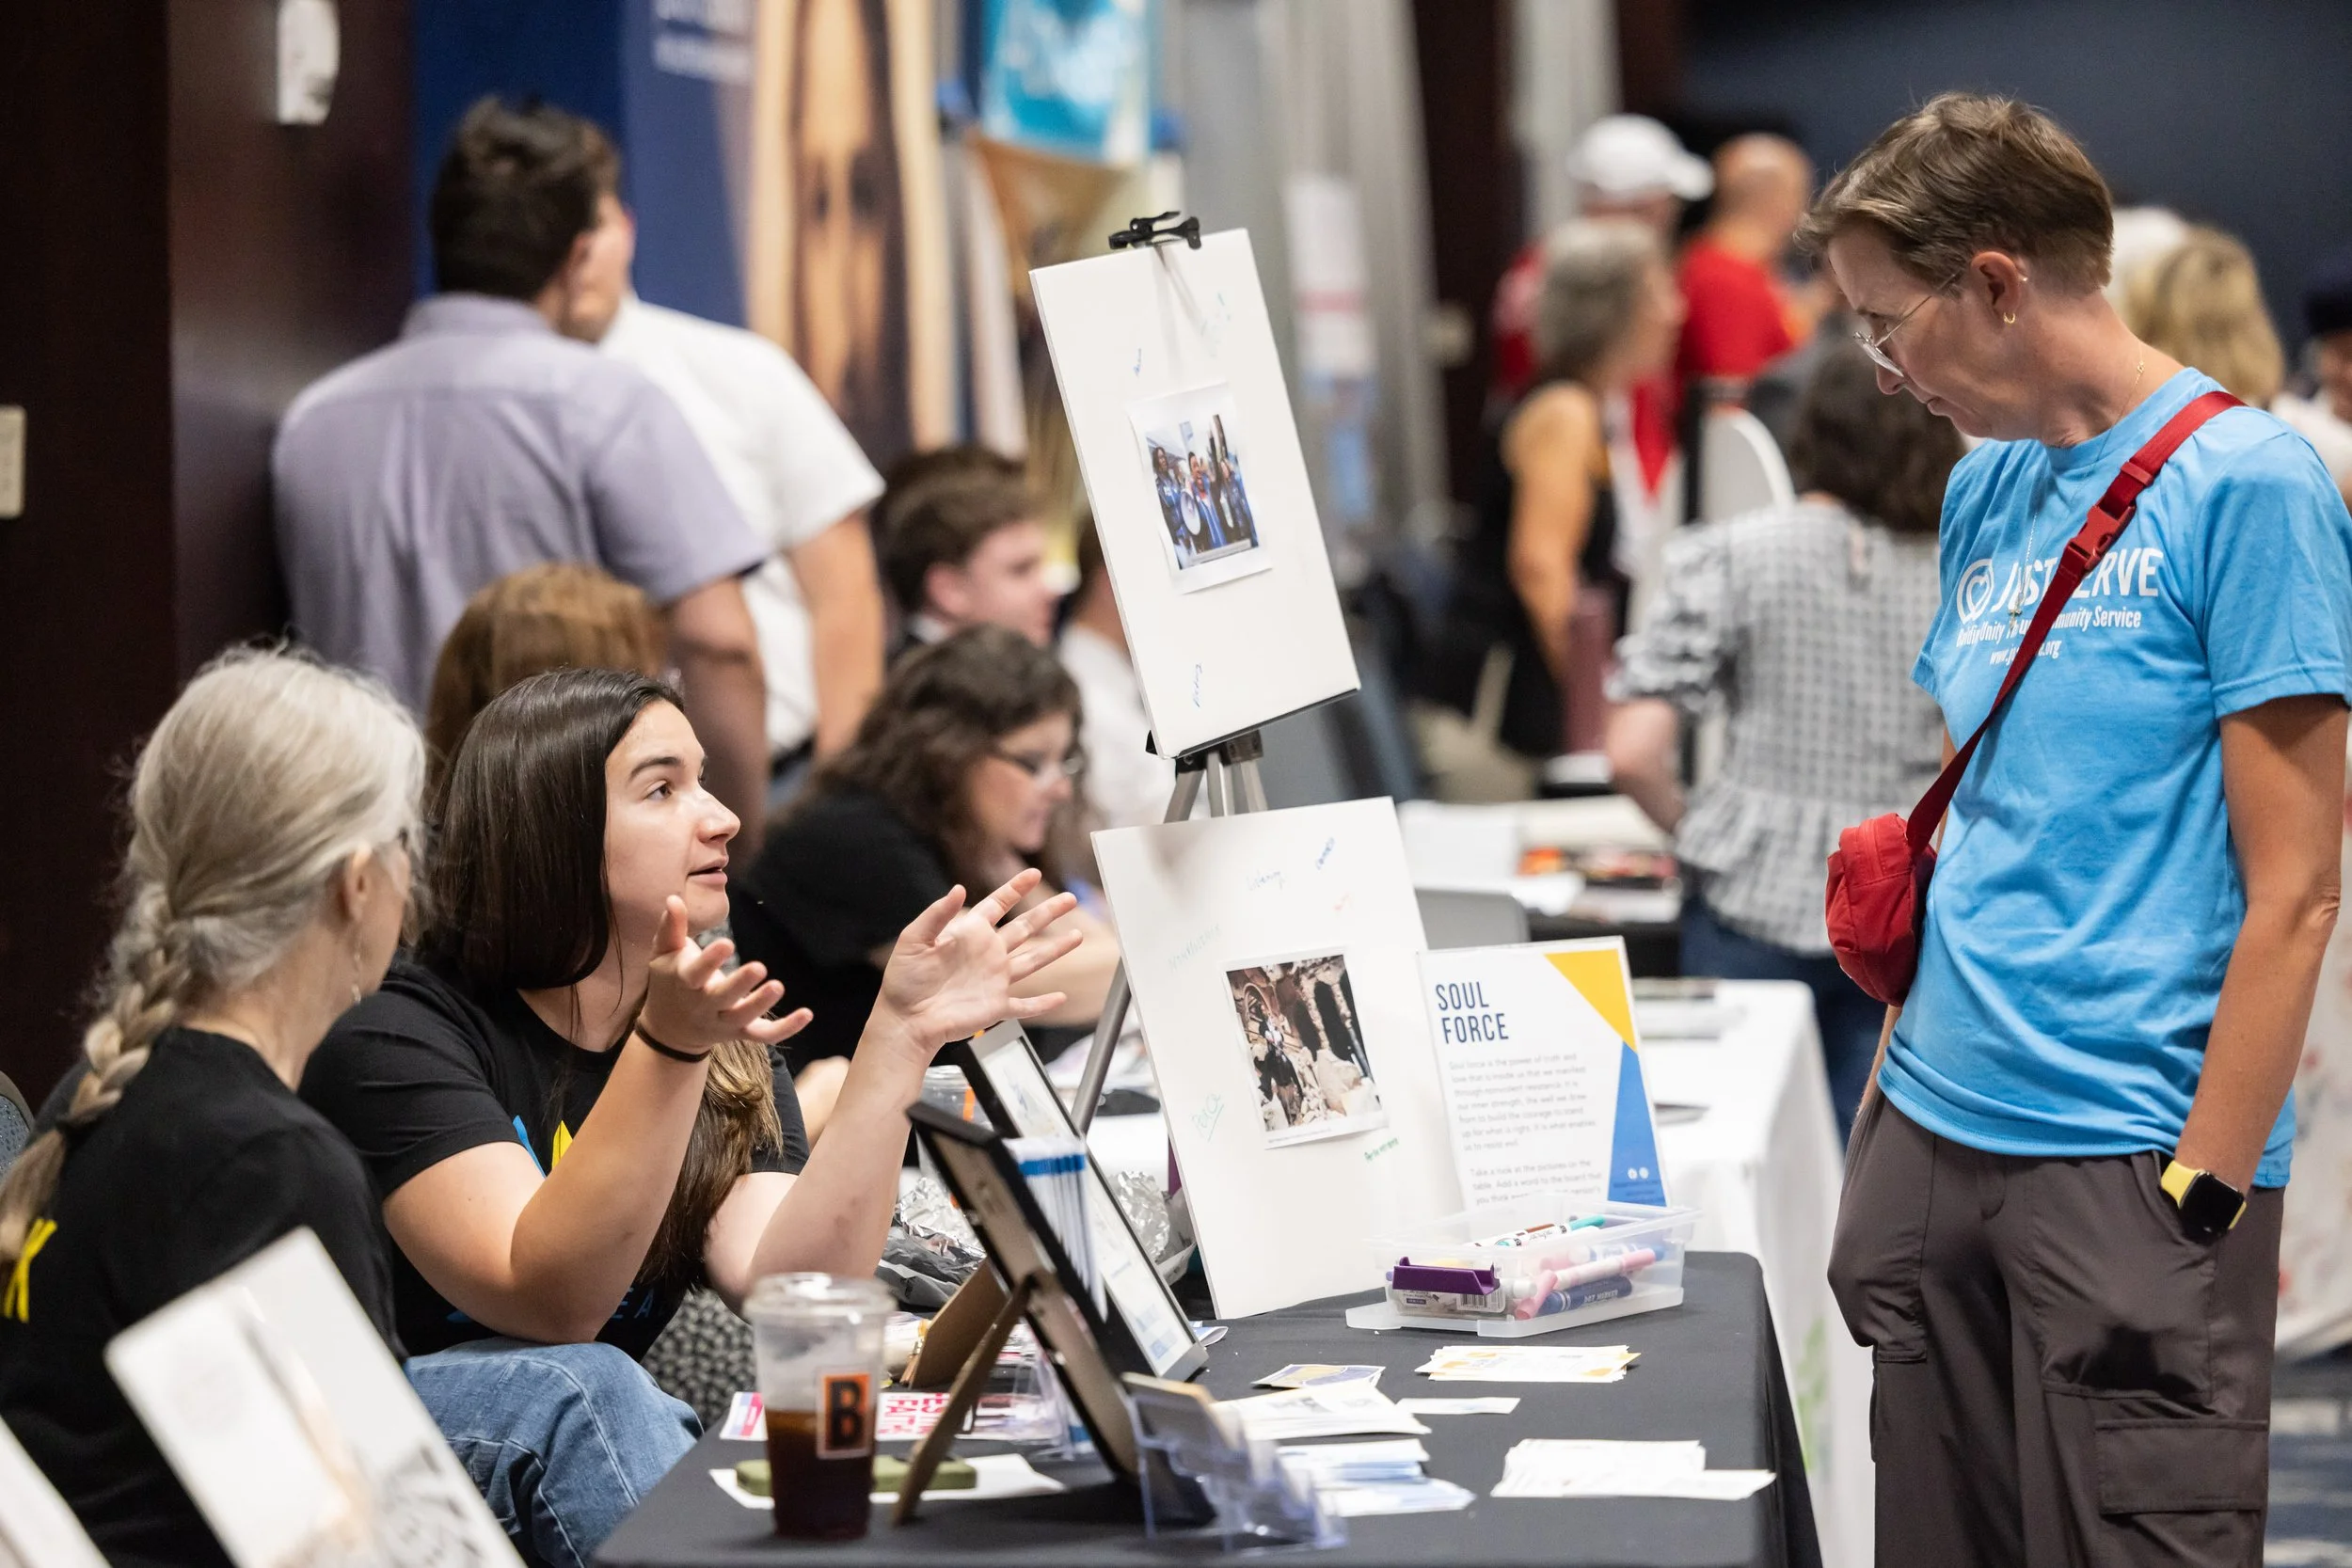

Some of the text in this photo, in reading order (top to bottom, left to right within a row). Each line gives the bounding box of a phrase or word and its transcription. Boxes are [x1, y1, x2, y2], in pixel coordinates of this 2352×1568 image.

[2092, 605, 2141, 628] Service
[1435, 981, 1489, 1011] SOUL
[1441, 1013, 1509, 1044] FORCE
[831, 1382, 864, 1447] B
